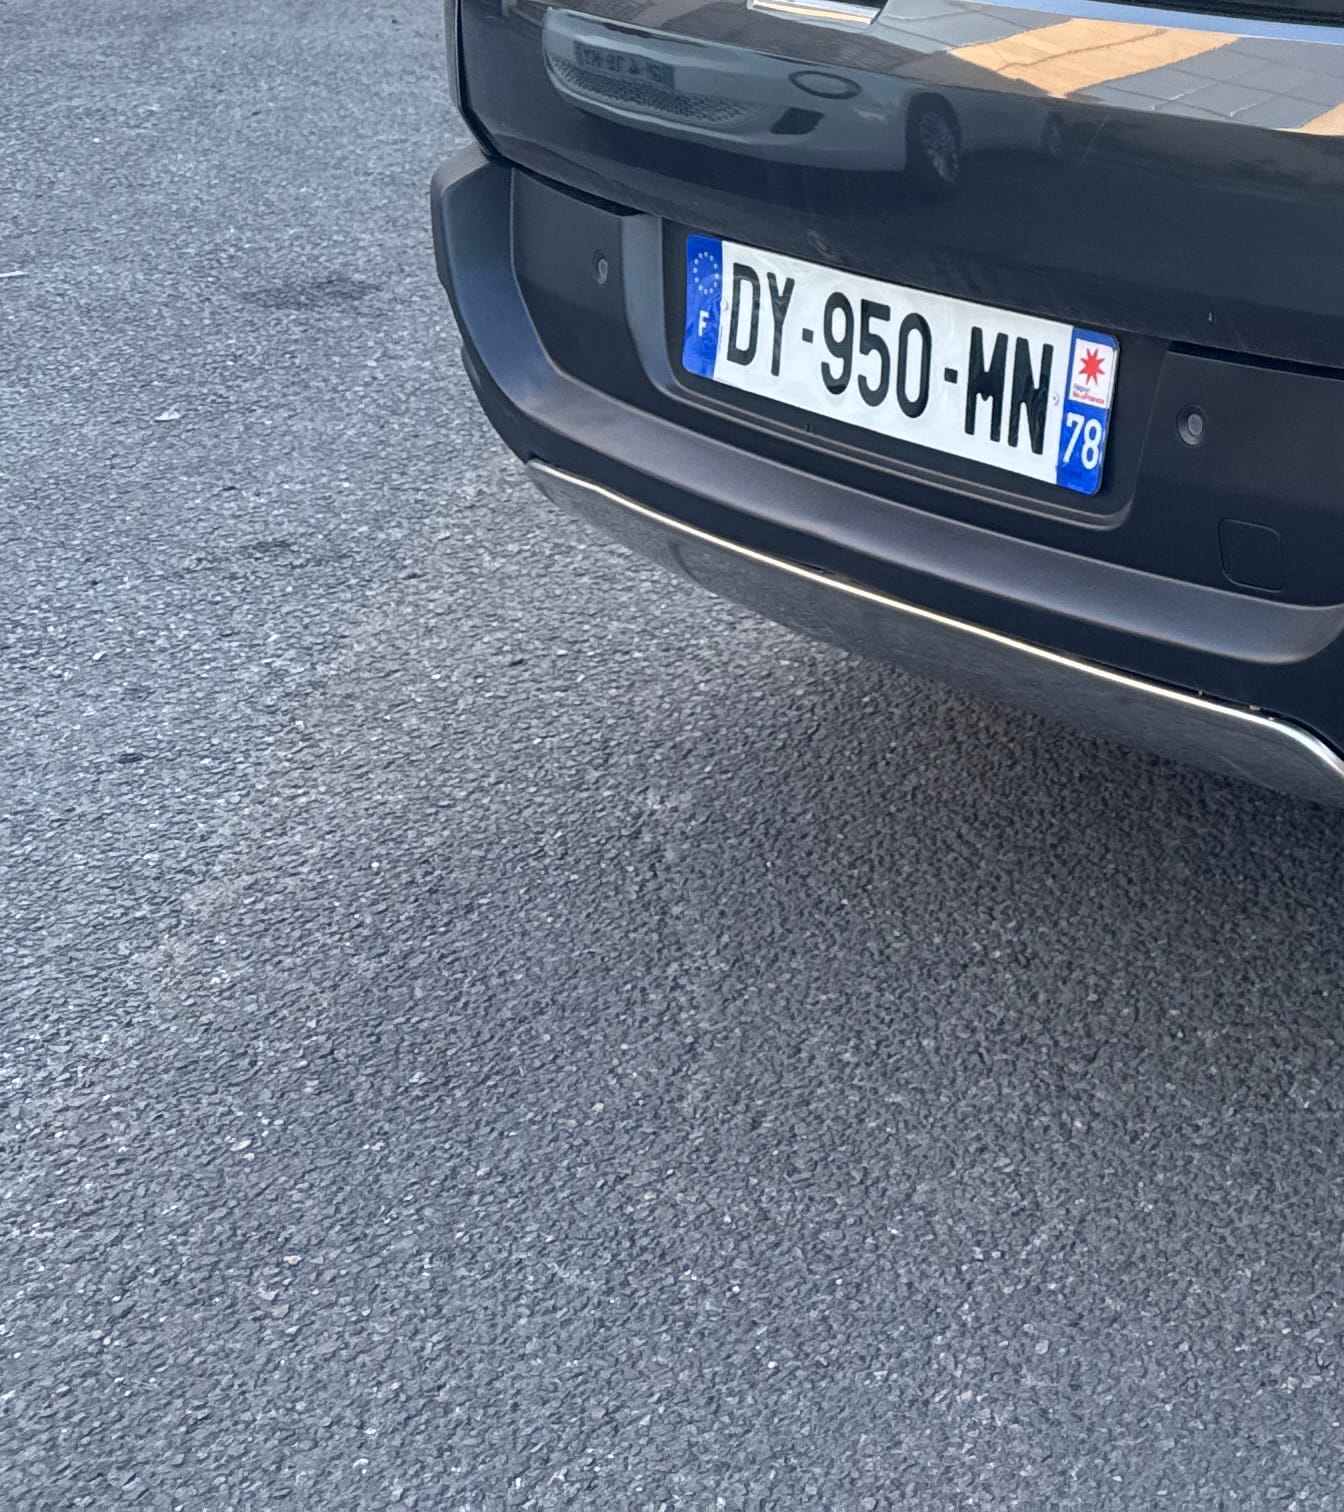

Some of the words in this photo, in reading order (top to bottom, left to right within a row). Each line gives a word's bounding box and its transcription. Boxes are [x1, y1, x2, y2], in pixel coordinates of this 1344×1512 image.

[698, 309, 710, 338] F
[726, 262, 1054, 455] DY-950-MN
[1062, 411, 1103, 470] 78
